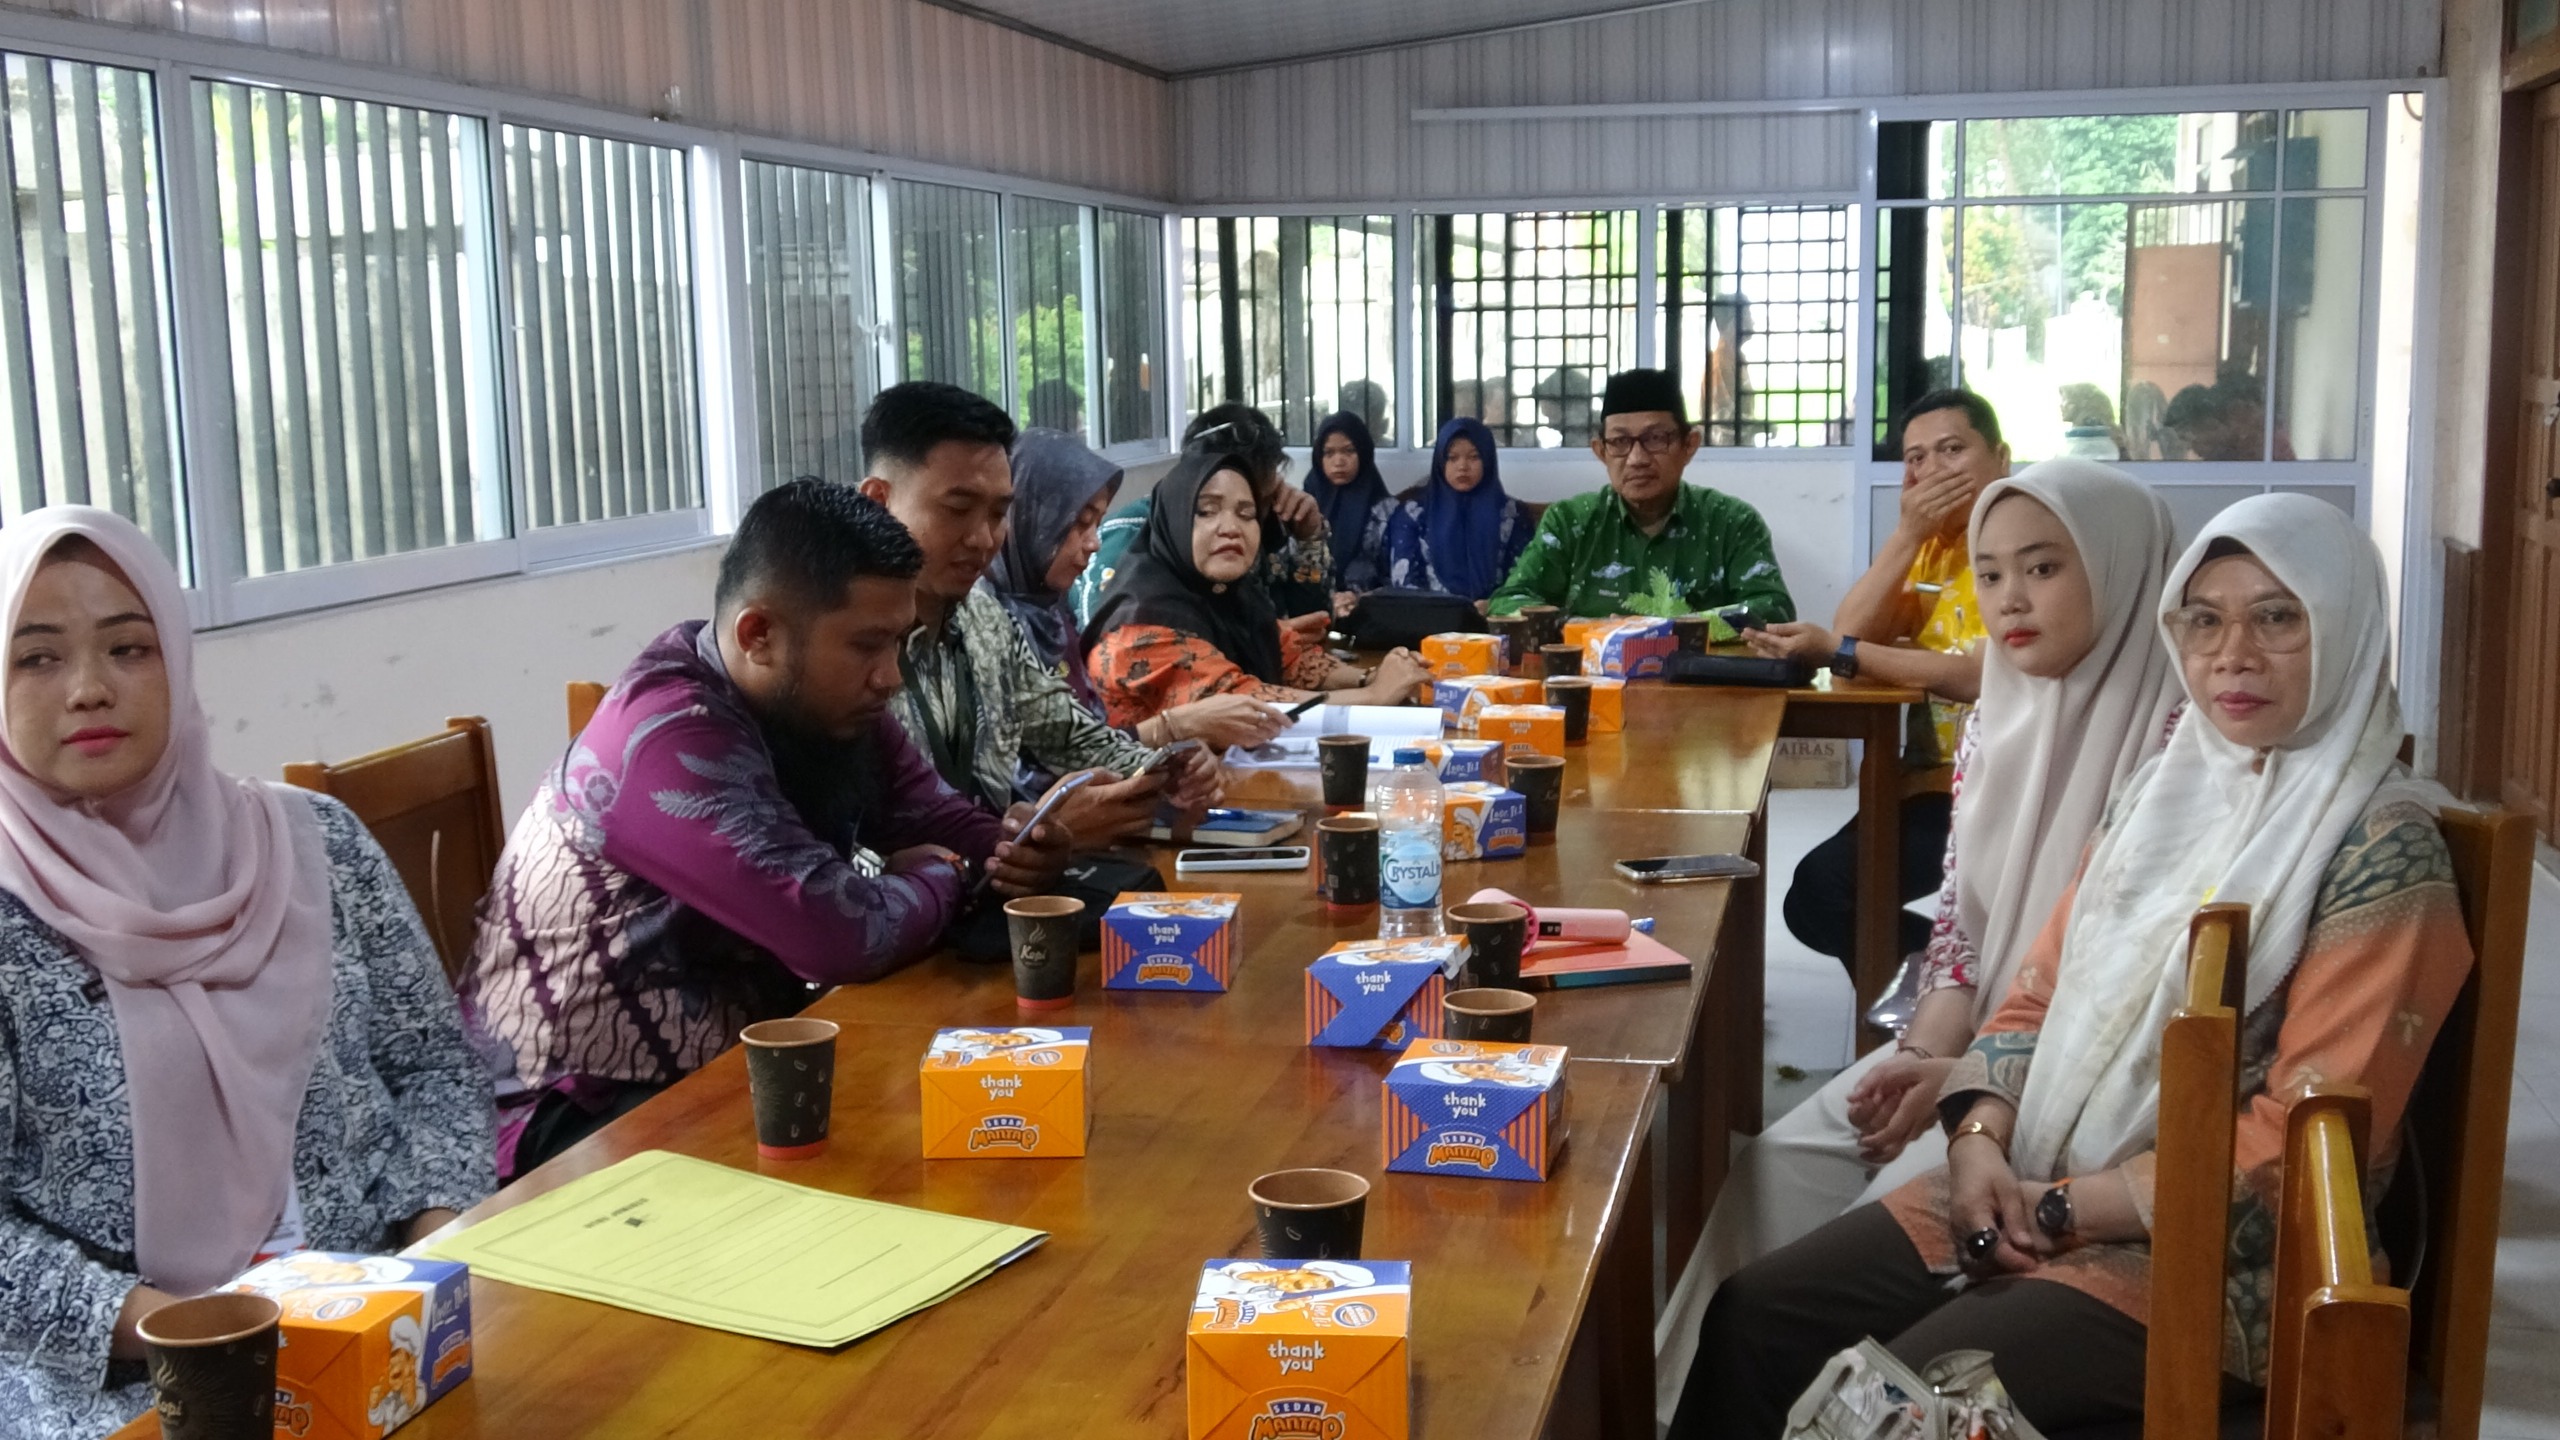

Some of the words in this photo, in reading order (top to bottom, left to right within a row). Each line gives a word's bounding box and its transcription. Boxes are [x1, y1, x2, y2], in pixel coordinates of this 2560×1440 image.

[1147, 922, 1181, 936] thank
[1154, 935, 1175, 945] you
[1020, 945, 1048, 962] Kopi
[1355, 971, 1392, 985] thank
[1363, 983, 1385, 995] you
[980, 1074, 1022, 1089] thank
[989, 1087, 1014, 1101] you
[1443, 1091, 1487, 1108] thank
[1452, 1106, 1478, 1119] you
[986, 1118, 1023, 1129] SEDAP
[1445, 1134, 1482, 1146] SEDAP
[1267, 1339, 1326, 1359] thank
[1280, 1358, 1314, 1375] you
[1273, 1402, 1323, 1415] SEDAP
